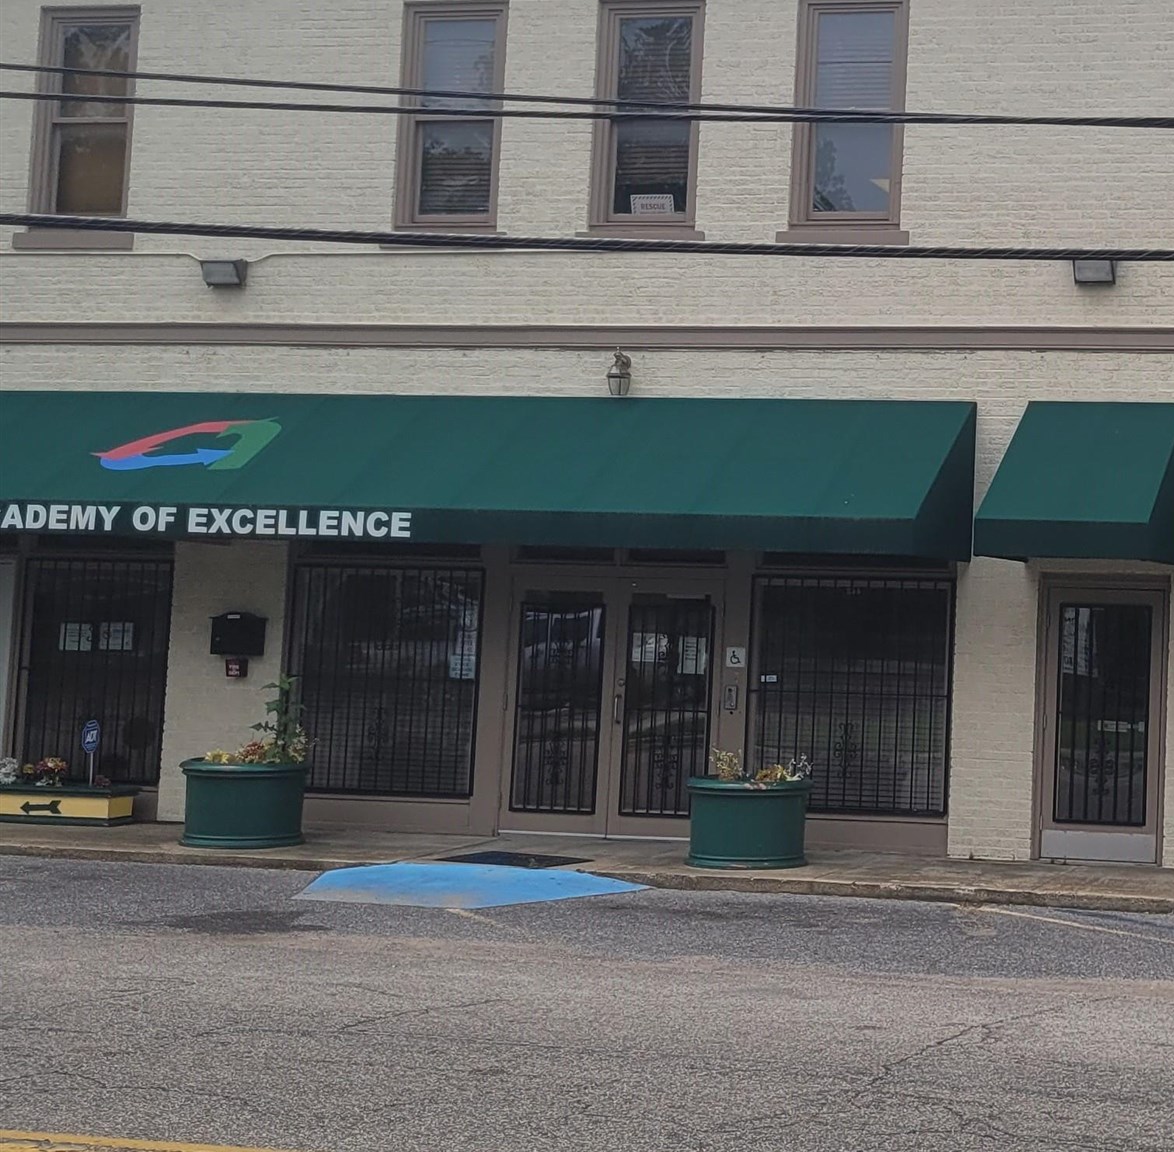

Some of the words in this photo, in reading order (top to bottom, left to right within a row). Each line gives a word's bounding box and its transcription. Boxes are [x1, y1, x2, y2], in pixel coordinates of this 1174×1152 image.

[0, 504, 121, 531] ADEMY
[132, 505, 177, 532] OF
[187, 507, 412, 538] EXCELLENCE
